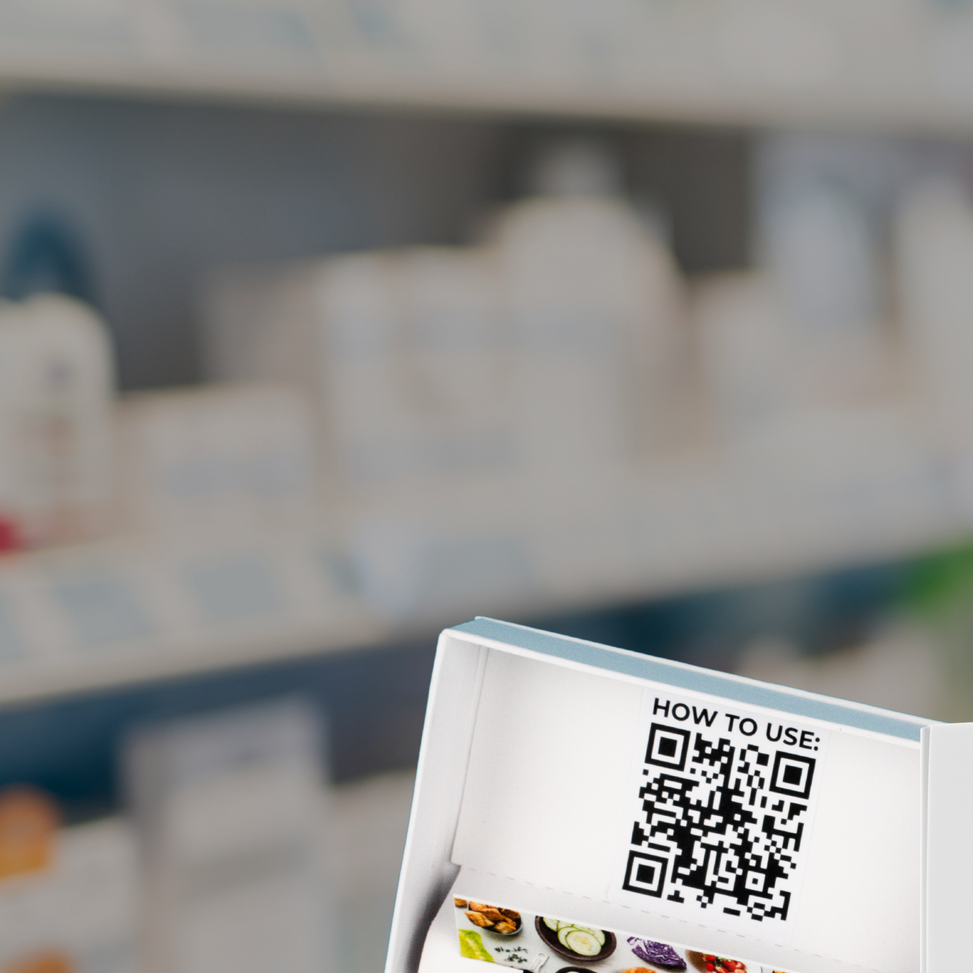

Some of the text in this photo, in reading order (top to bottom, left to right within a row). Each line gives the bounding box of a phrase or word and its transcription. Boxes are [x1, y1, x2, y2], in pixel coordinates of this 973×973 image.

[652, 697, 820, 751] HOW TO USE:
